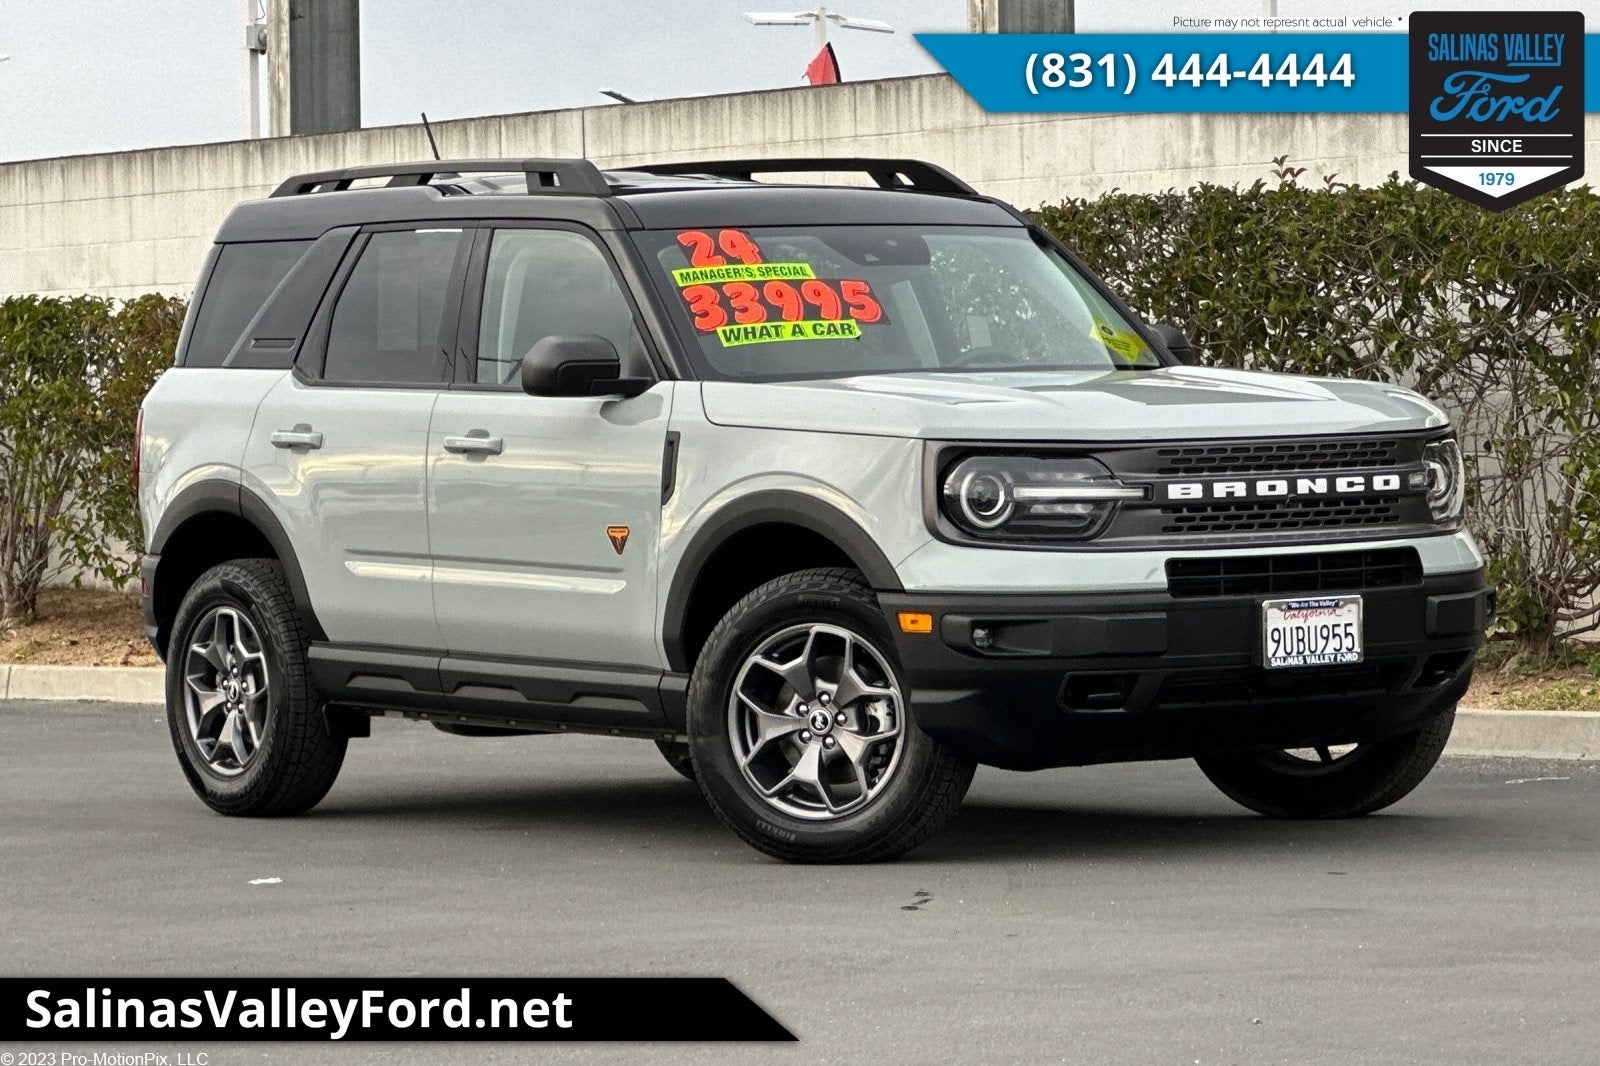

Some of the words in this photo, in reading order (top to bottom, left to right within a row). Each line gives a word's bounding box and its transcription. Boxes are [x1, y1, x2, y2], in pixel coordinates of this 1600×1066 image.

[676, 229, 763, 267] 24
[679, 267, 756, 284] MANAGER'S
[757, 265, 809, 279] SPECIAL
[682, 280, 882, 332] 33995
[722, 324, 785, 343] WHAT
[791, 323, 806, 337] A
[812, 323, 856, 336] CAR
[1167, 474, 1401, 500] BRONCO
[1283, 608, 1342, 623] California
[1271, 623, 1355, 657] 9UBU955
[1270, 655, 1304, 667] SALINAS
[1306, 653, 1335, 665] VALLEY
[1336, 652, 1359, 663] FORD
